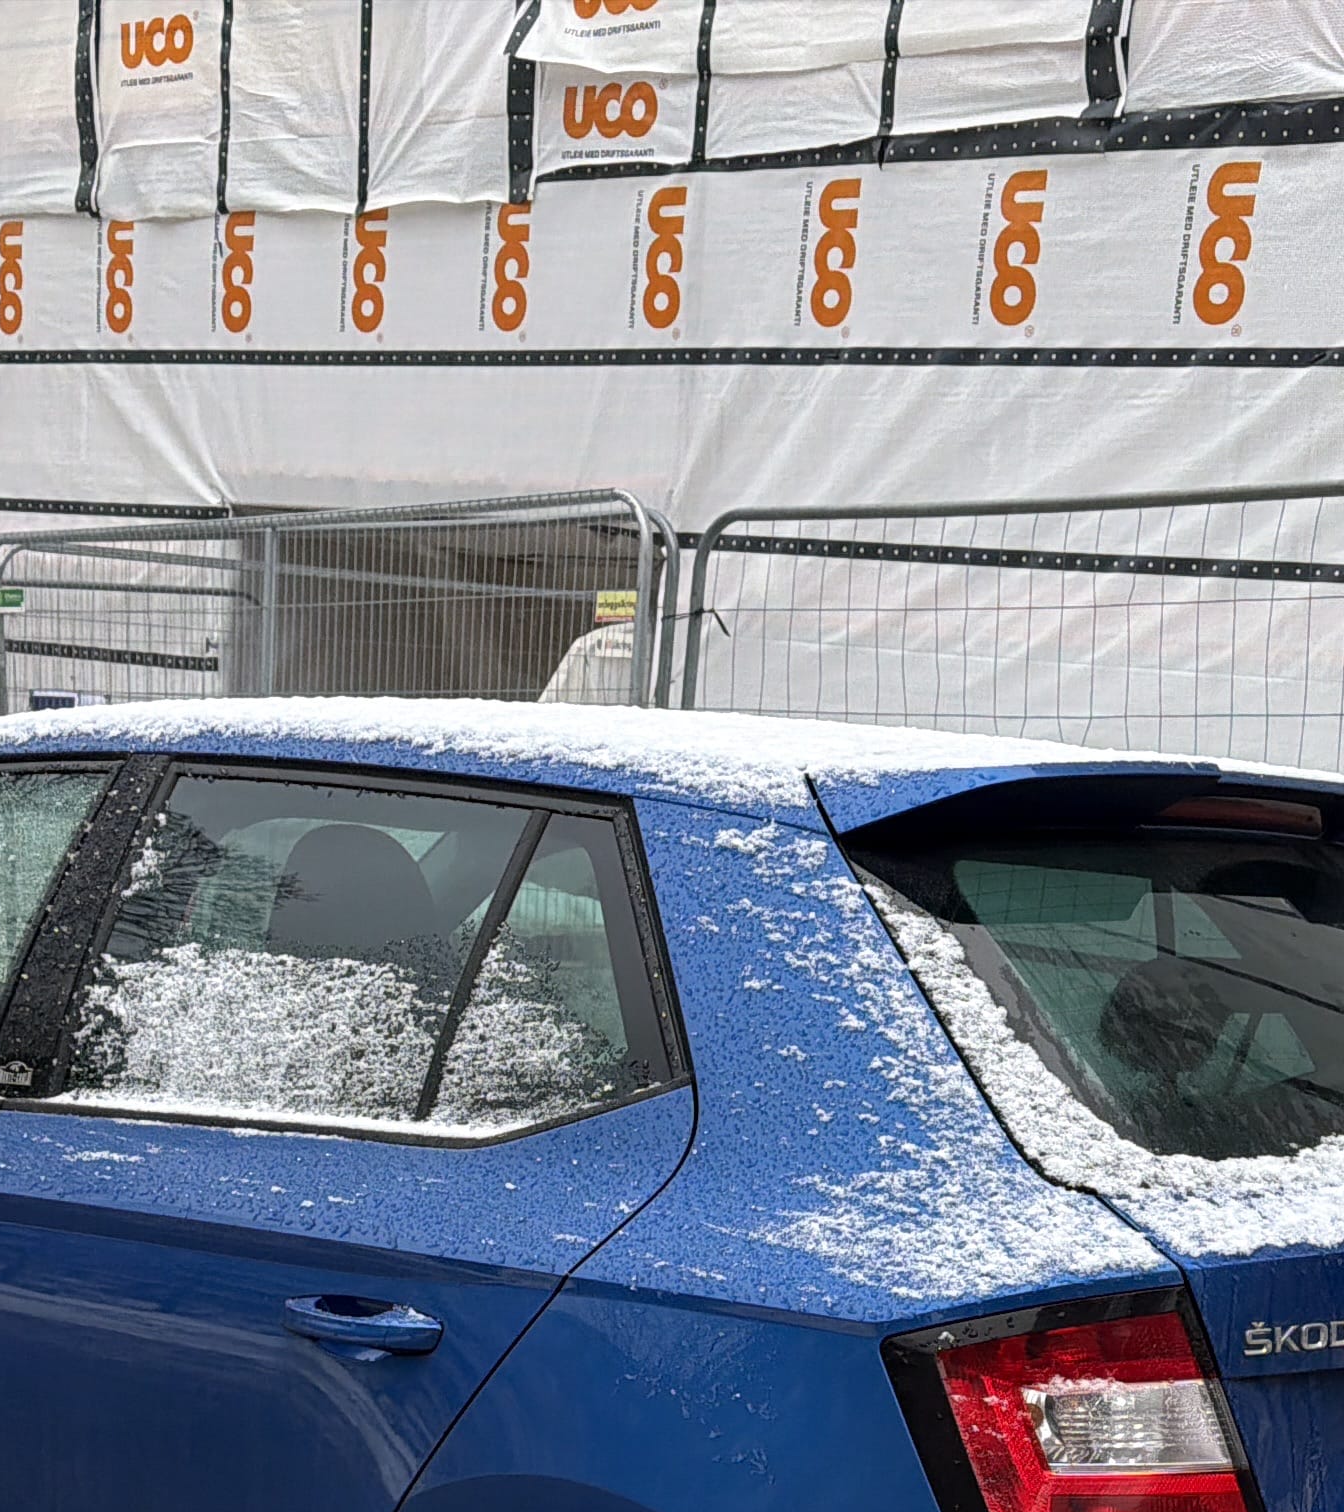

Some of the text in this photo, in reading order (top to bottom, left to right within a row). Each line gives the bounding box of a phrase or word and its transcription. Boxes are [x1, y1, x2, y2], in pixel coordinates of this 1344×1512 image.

[120, 14, 194, 70] UCO
[563, 81, 658, 139] UCO
[642, 186, 687, 329] UCO
[804, 181, 813, 216] UTLEIE
[810, 178, 861, 327] UCO
[971, 173, 995, 325] UTLEIE MED DRIFTSGARANTI
[990, 169, 1048, 326] UCO
[1173, 164, 1200, 324] UTLEIE MED DRIFTSGARANTI
[1193, 161, 1262, 326] UCO
[106, 220, 134, 333] UCO
[221, 210, 255, 333] UCO
[352, 207, 389, 333] UCO
[491, 202, 531, 332] UCO
[628, 250, 638, 329] DRIFTSGARANTI
[794, 245, 807, 326] DRIFTSGARANTI
